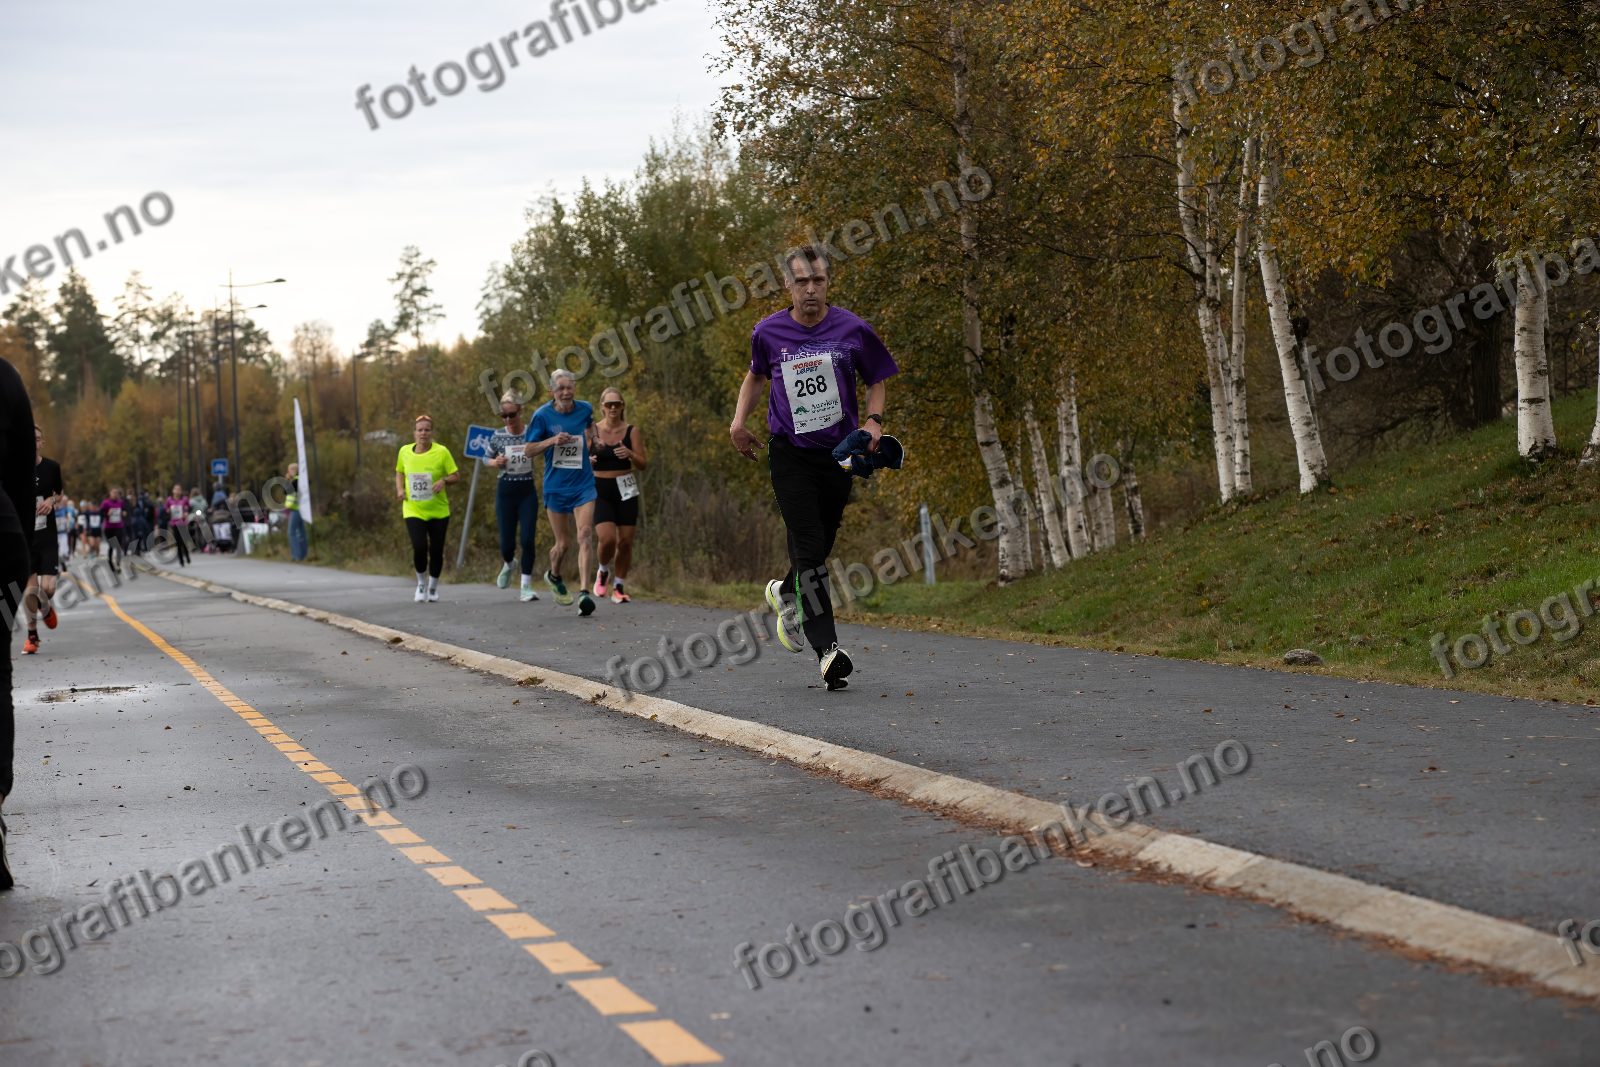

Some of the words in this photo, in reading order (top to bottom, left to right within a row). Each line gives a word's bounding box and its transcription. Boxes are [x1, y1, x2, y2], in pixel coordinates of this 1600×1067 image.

[795, 375, 828, 397] 268
[559, 446, 578, 457] 752
[510, 455, 526, 464] 216
